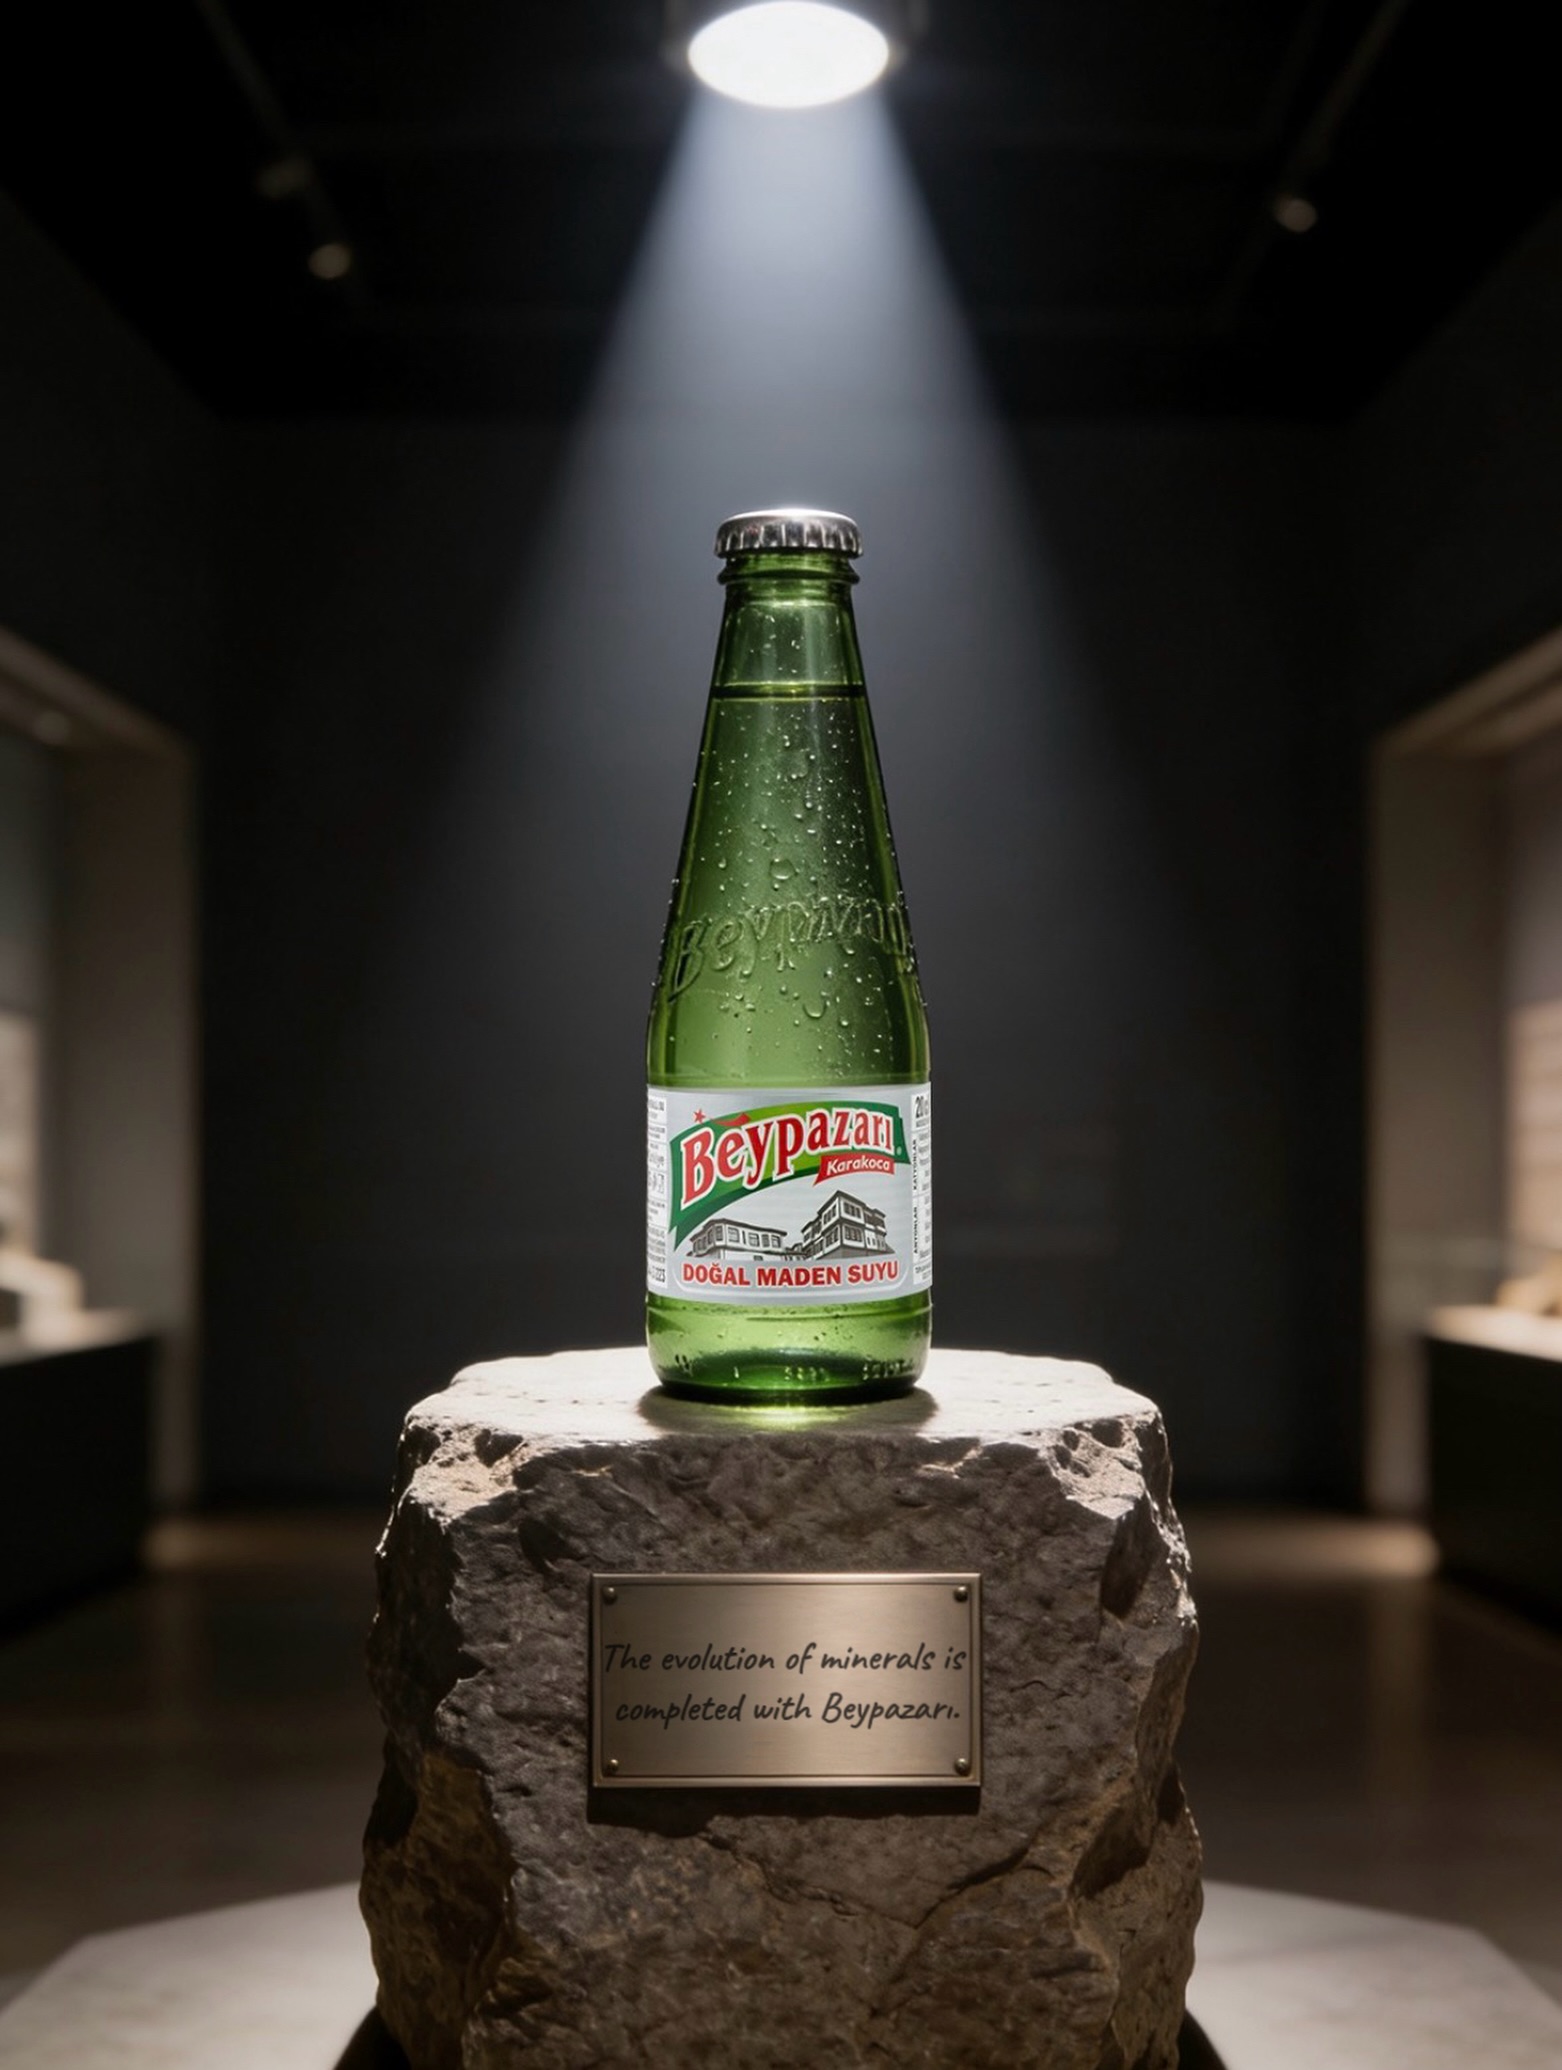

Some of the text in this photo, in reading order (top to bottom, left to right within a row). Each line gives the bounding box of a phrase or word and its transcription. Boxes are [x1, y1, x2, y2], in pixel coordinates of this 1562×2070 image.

[681, 1107, 895, 1209] Beypazarı
[827, 1154, 891, 1175] Karakoca
[683, 1262, 750, 1286] DOĞAL
[757, 1267, 842, 1287] MADEN
[847, 1260, 899, 1281] SUYU
[605, 1642, 967, 1675] The evolution of minerals is
[615, 1692, 961, 1730] completed with Beypazarı.
